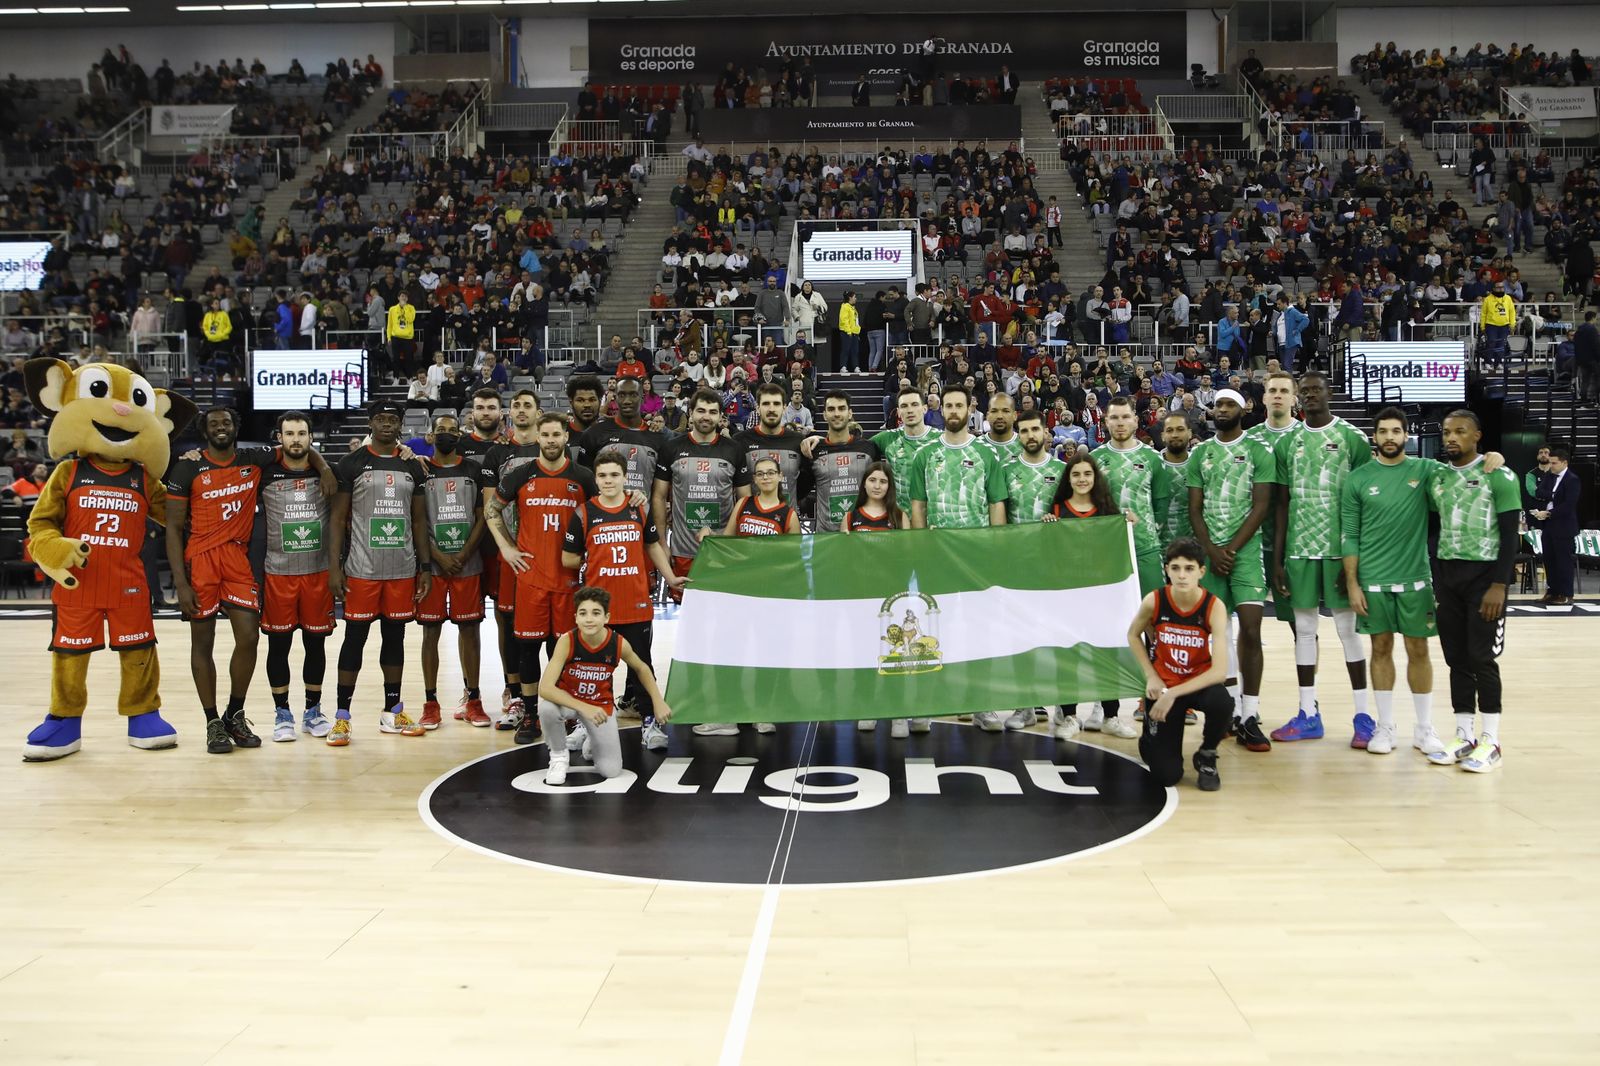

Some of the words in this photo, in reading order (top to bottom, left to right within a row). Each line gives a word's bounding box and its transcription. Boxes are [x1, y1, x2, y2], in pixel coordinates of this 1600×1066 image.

[620, 44, 696, 58] Granada
[766, 41, 896, 57] AYUNTAMIENTO
[1083, 39, 1160, 53] Granada
[620, 61, 635, 70] es
[639, 59, 695, 72] deporte
[1084, 56, 1101, 66] es
[1105, 52, 1160, 66] música
[807, 120, 864, 128] AYUNTAMIENTO
[813, 247, 872, 262] Granada
[875, 247, 901, 263] Hoy
[1351, 361, 1422, 378] Granada
[1426, 361, 1460, 382] Hoy
[257, 369, 328, 386] Granada
[331, 369, 362, 388] Hoy
[696, 460, 711, 472] 32
[836, 456, 850, 467] 50
[386, 474, 395, 486] 3
[445, 480, 457, 493] 12
[831, 478, 857, 486] CERVEZAS
[830, 484, 859, 493] ALHAMBRA
[79, 496, 138, 513] GRANADA
[285, 503, 317, 511] CERVEZAS
[375, 499, 403, 507] CERVEZAS
[438, 505, 465, 513] CERVEZAS
[221, 500, 242, 520] 24
[284, 511, 319, 519] ALHAMBRA
[373, 507, 404, 515] ALHAMBRA
[95, 513, 120, 533] 73
[543, 514, 560, 532] 14
[81, 534, 129, 547] PULEVA
[593, 530, 640, 544] GRANADA
[611, 546, 627, 563] 13
[599, 566, 639, 576] PULEVA
[60, 635, 93, 645] PULEVA
[1159, 632, 1205, 648] GRANADA
[1170, 648, 1189, 666] 49
[569, 668, 611, 680] GRANADA
[579, 682, 596, 694] 68
[511, 757, 1099, 812] alight
